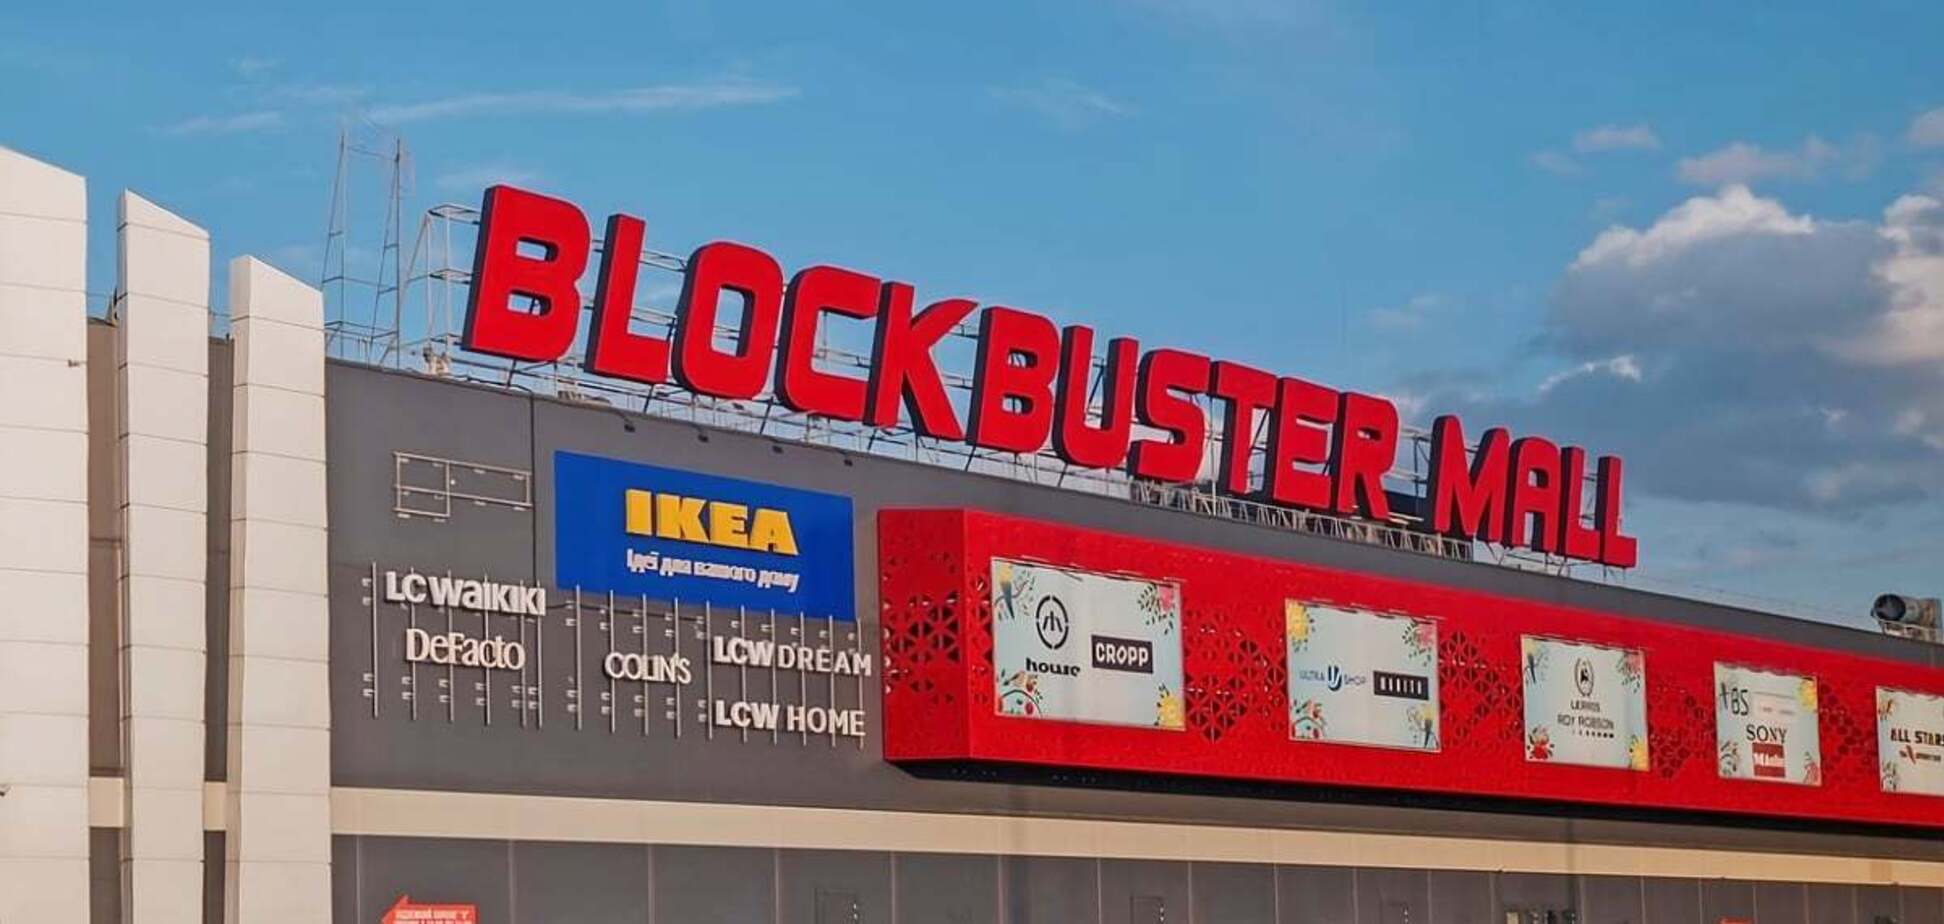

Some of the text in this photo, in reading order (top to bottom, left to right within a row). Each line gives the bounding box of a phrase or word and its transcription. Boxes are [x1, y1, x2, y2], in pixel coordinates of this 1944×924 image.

[463, 184, 1637, 568] BLOCKBUSTER MALL
[625, 489, 799, 556] IKEA
[406, 628, 526, 670] DeFacto
[713, 636, 872, 677] LCW DREAM
[1095, 642, 1149, 668] CROPP
[715, 700, 866, 736] LCW HOME
[1746, 724, 1787, 744] SONY
[1890, 727, 1911, 743] ALL
